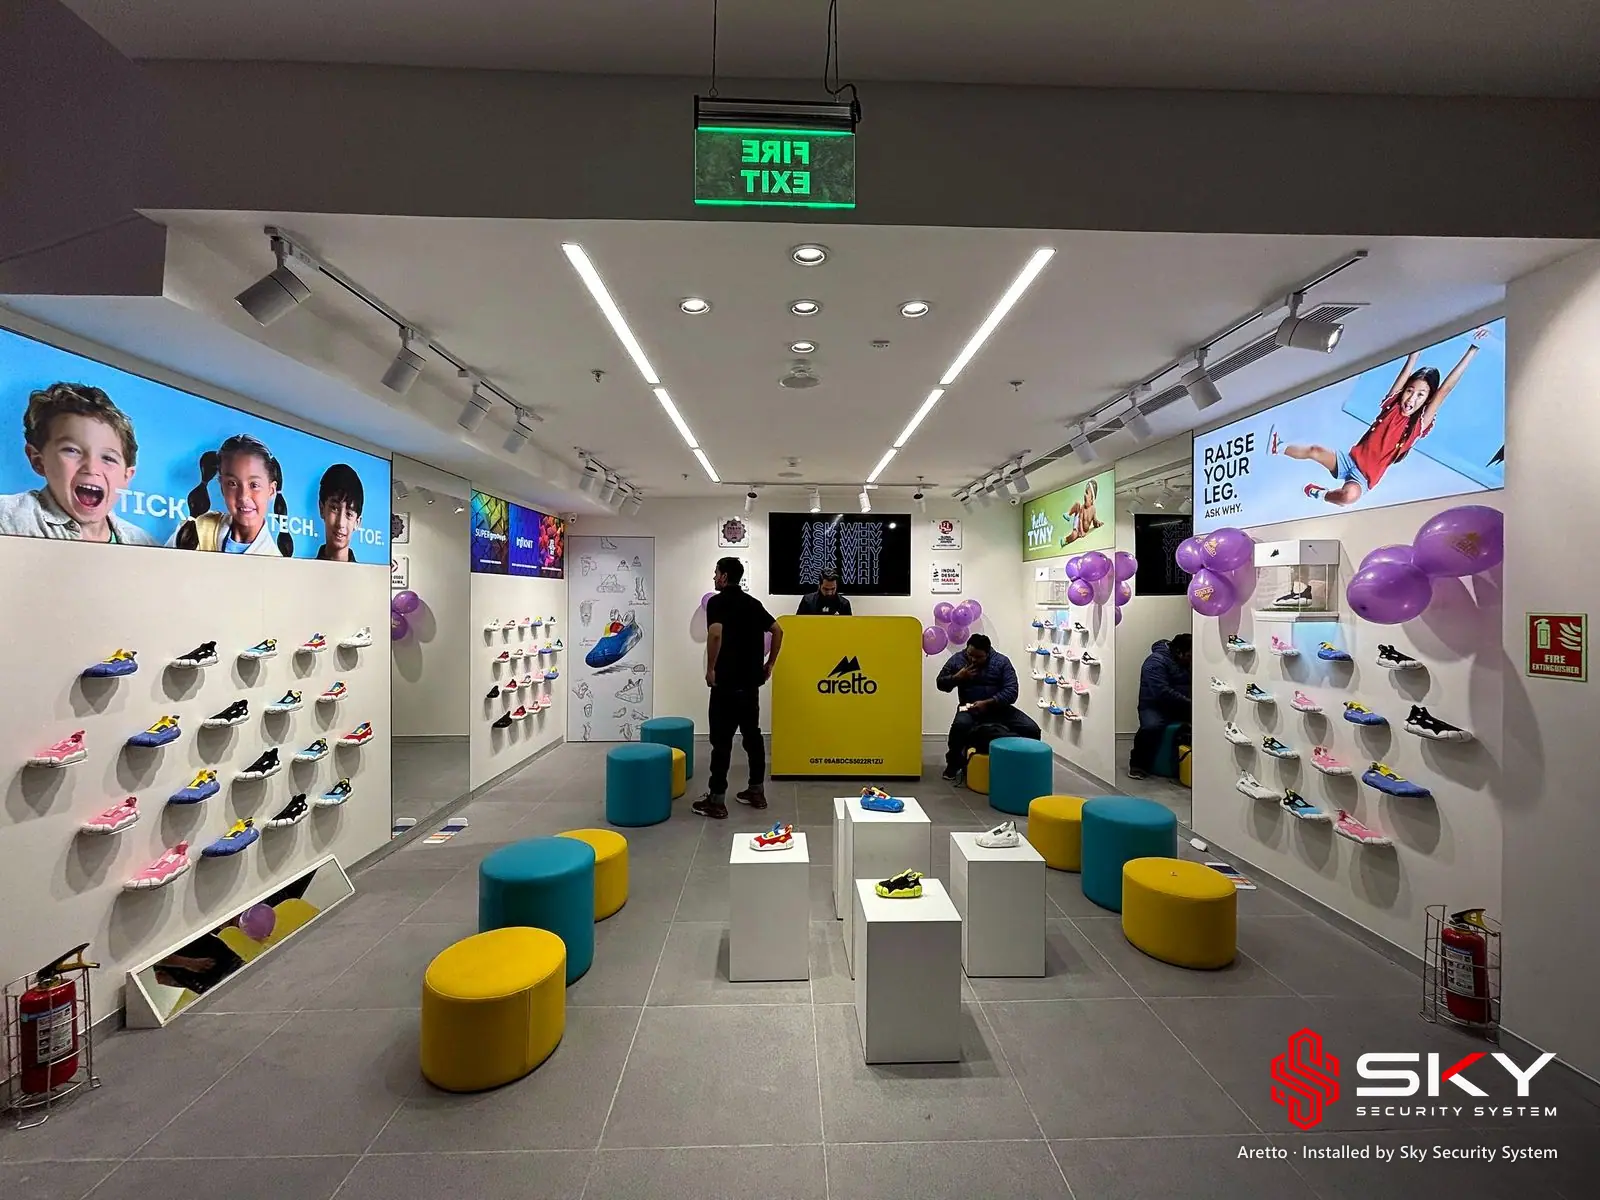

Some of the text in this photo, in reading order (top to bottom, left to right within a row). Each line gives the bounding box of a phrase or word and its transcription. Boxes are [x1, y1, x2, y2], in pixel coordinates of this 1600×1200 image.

[1204, 432, 1254, 466] RAISE
[1203, 456, 1250, 485] YOUR
[1204, 482, 1238, 505] LEG.
[1204, 503, 1243, 519] ASK WHY.
[267, 512, 319, 537] TECH.
[357, 526, 385, 546] TOE.
[1027, 524, 1054, 547] TYNY
[799, 546, 882, 561] ASK WHY
[1532, 663, 1580, 674] EXTINGUISHER
[1544, 654, 1566, 664] FIRE
[817, 673, 877, 695] aretto
[809, 757, 823, 765] GST
